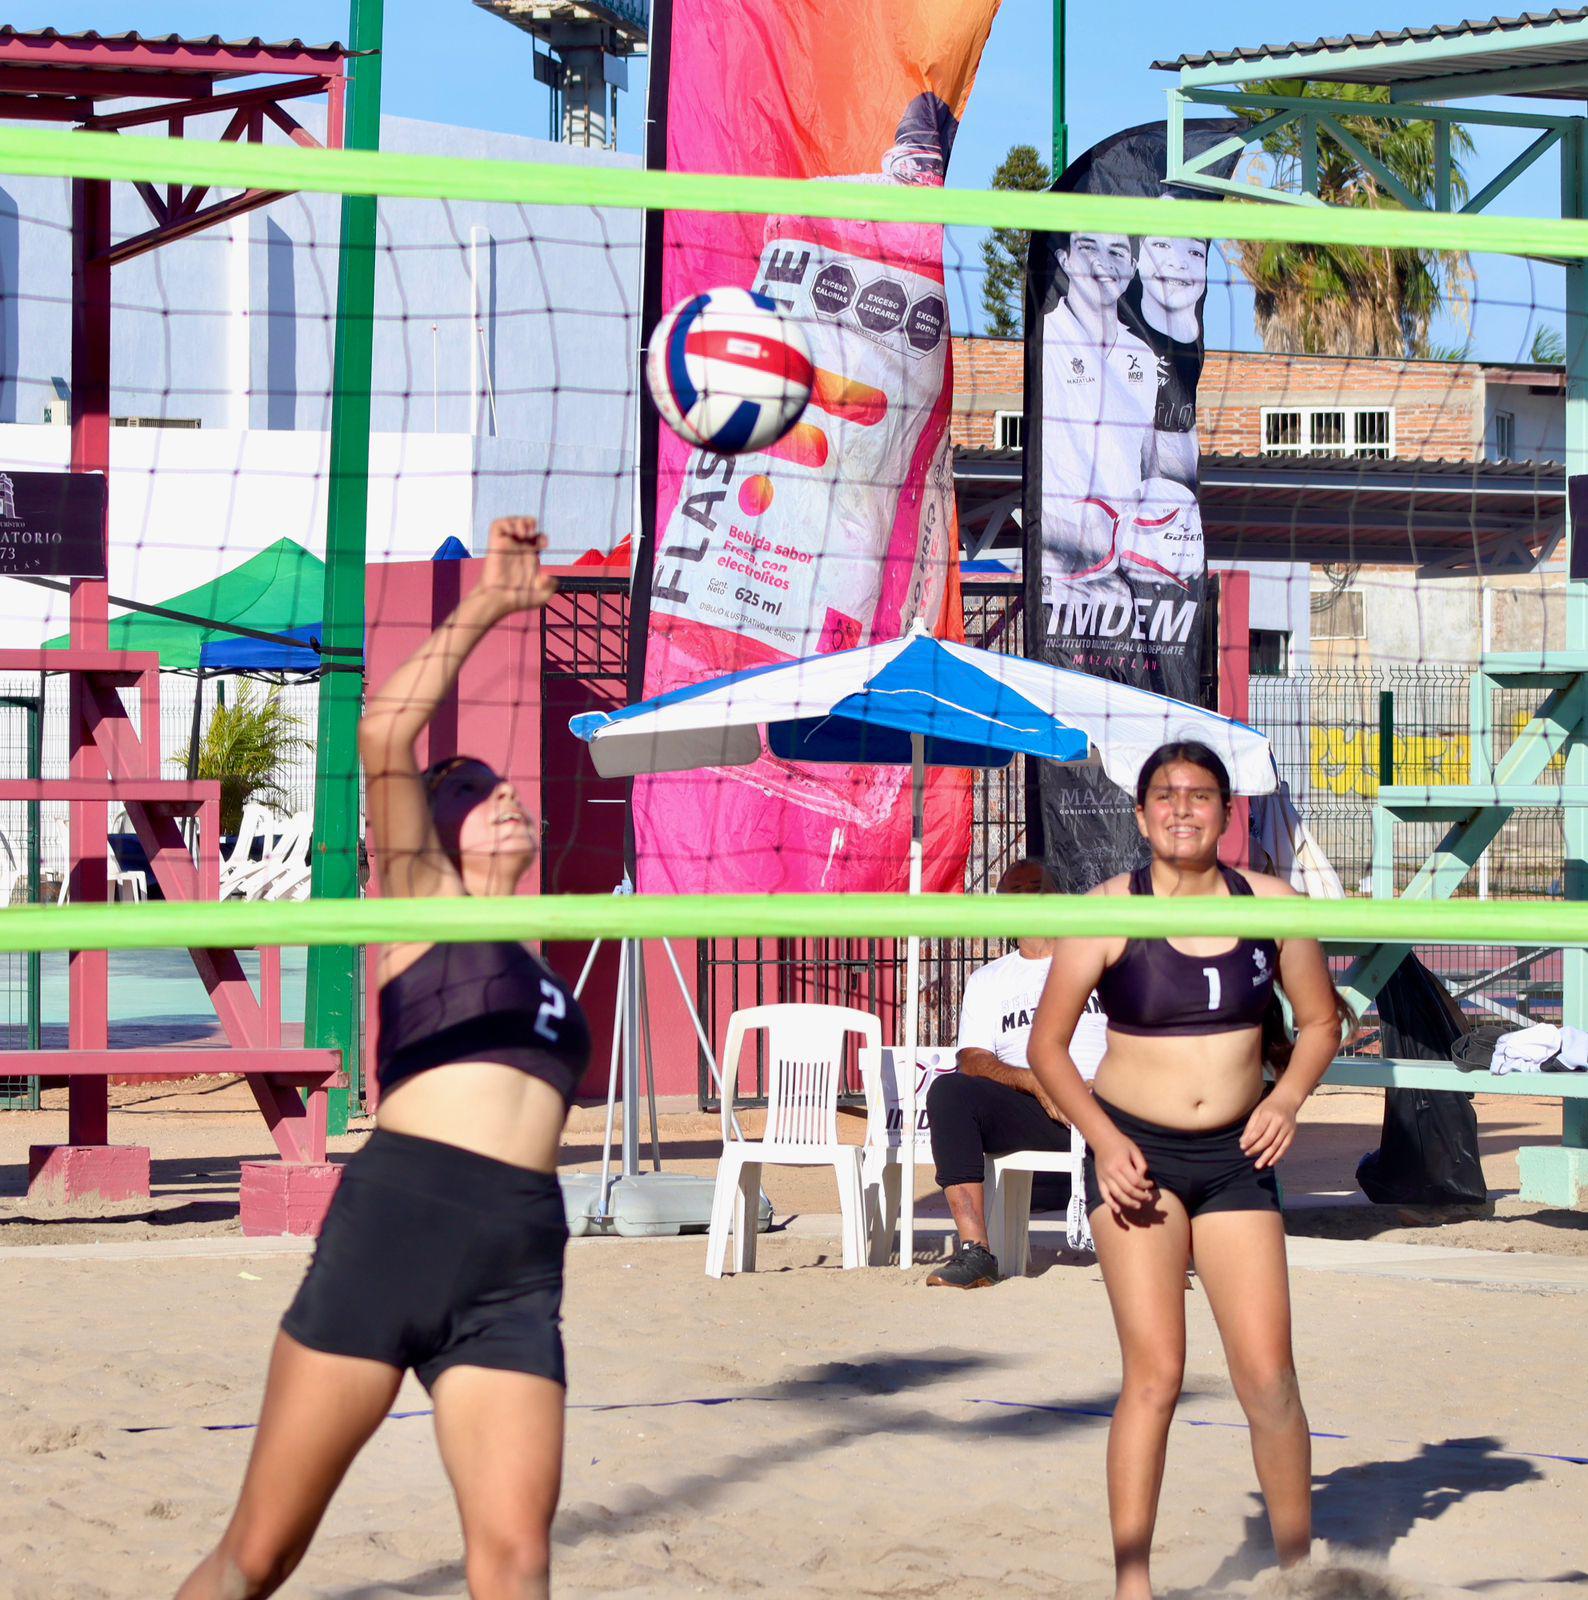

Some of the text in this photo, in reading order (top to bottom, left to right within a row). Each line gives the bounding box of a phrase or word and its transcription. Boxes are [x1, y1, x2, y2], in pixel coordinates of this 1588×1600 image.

[821, 278, 848, 293] EXCESO
[867, 293, 900, 310] EXCESO
[916, 311, 940, 327] EXCESO
[915, 322, 937, 336] SODIO
[728, 525, 815, 564] Bebida sabor
[717, 555, 791, 591] electrolitos
[761, 559, 788, 572] con
[707, 584, 725, 595] Neto
[735, 587, 783, 616] 625 ml
[699, 602, 725, 616] DIBUJO
[773, 625, 797, 643] SABOR
[1045, 637, 1091, 649] INSTITUTO
[1091, 639, 1135, 652] MUNICIPAL
[1098, 807, 1115, 815] QUE
[1202, 967, 1221, 1010] 1
[533, 978, 567, 1042] 2
